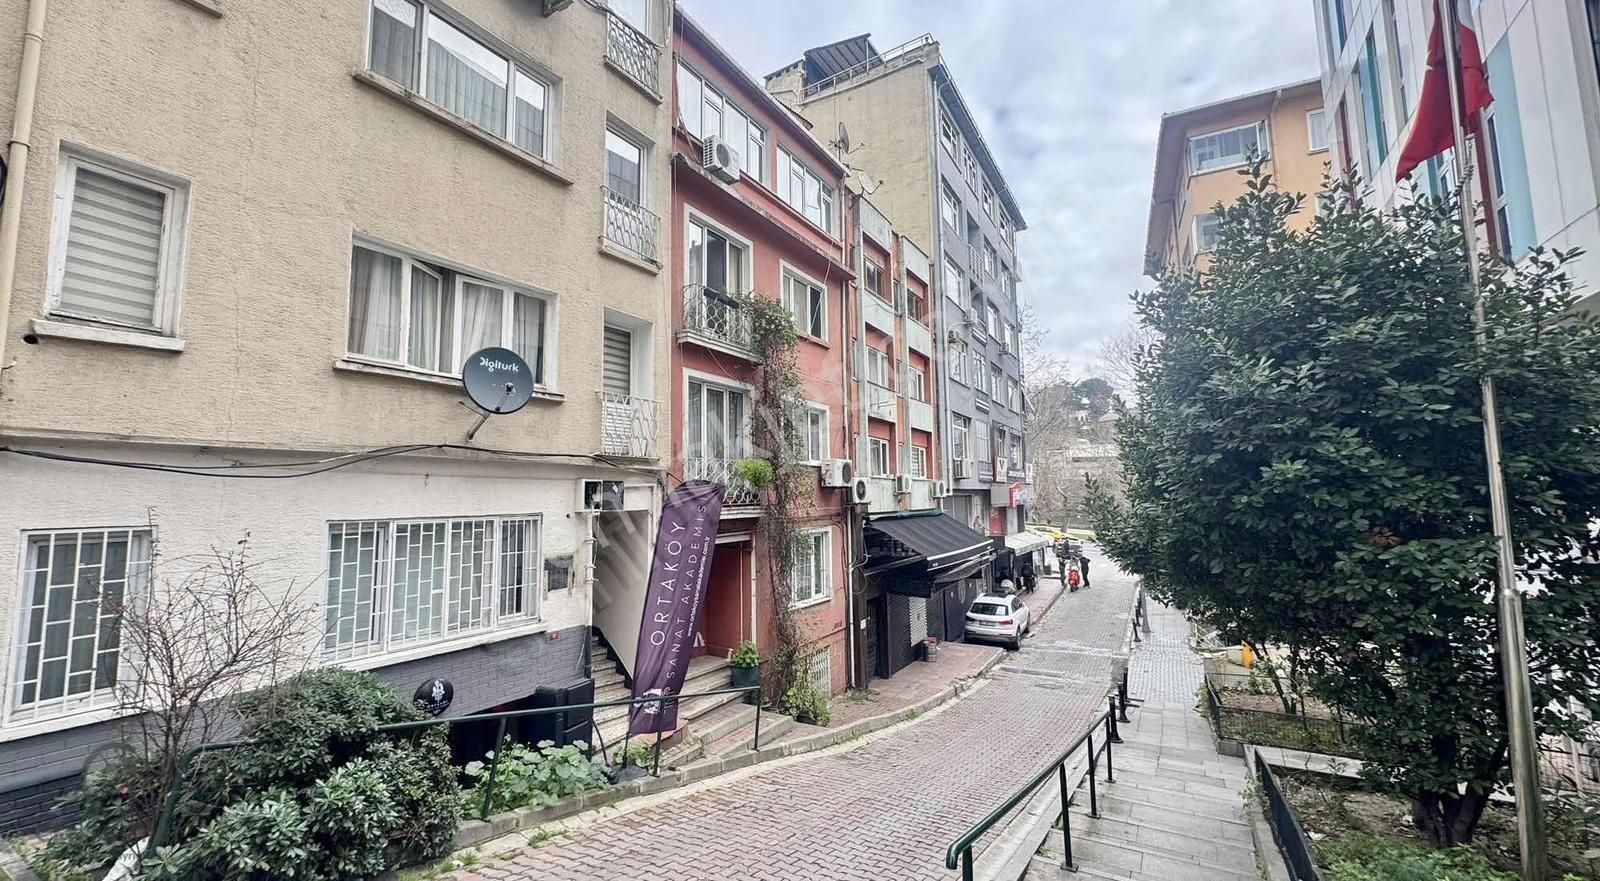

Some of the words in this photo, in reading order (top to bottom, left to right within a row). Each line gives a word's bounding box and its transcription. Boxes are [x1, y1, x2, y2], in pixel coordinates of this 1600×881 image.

[480, 357, 519, 373] Digiturk
[650, 522, 687, 646] ORTAKÖY
[666, 617, 688, 679] SANAT
